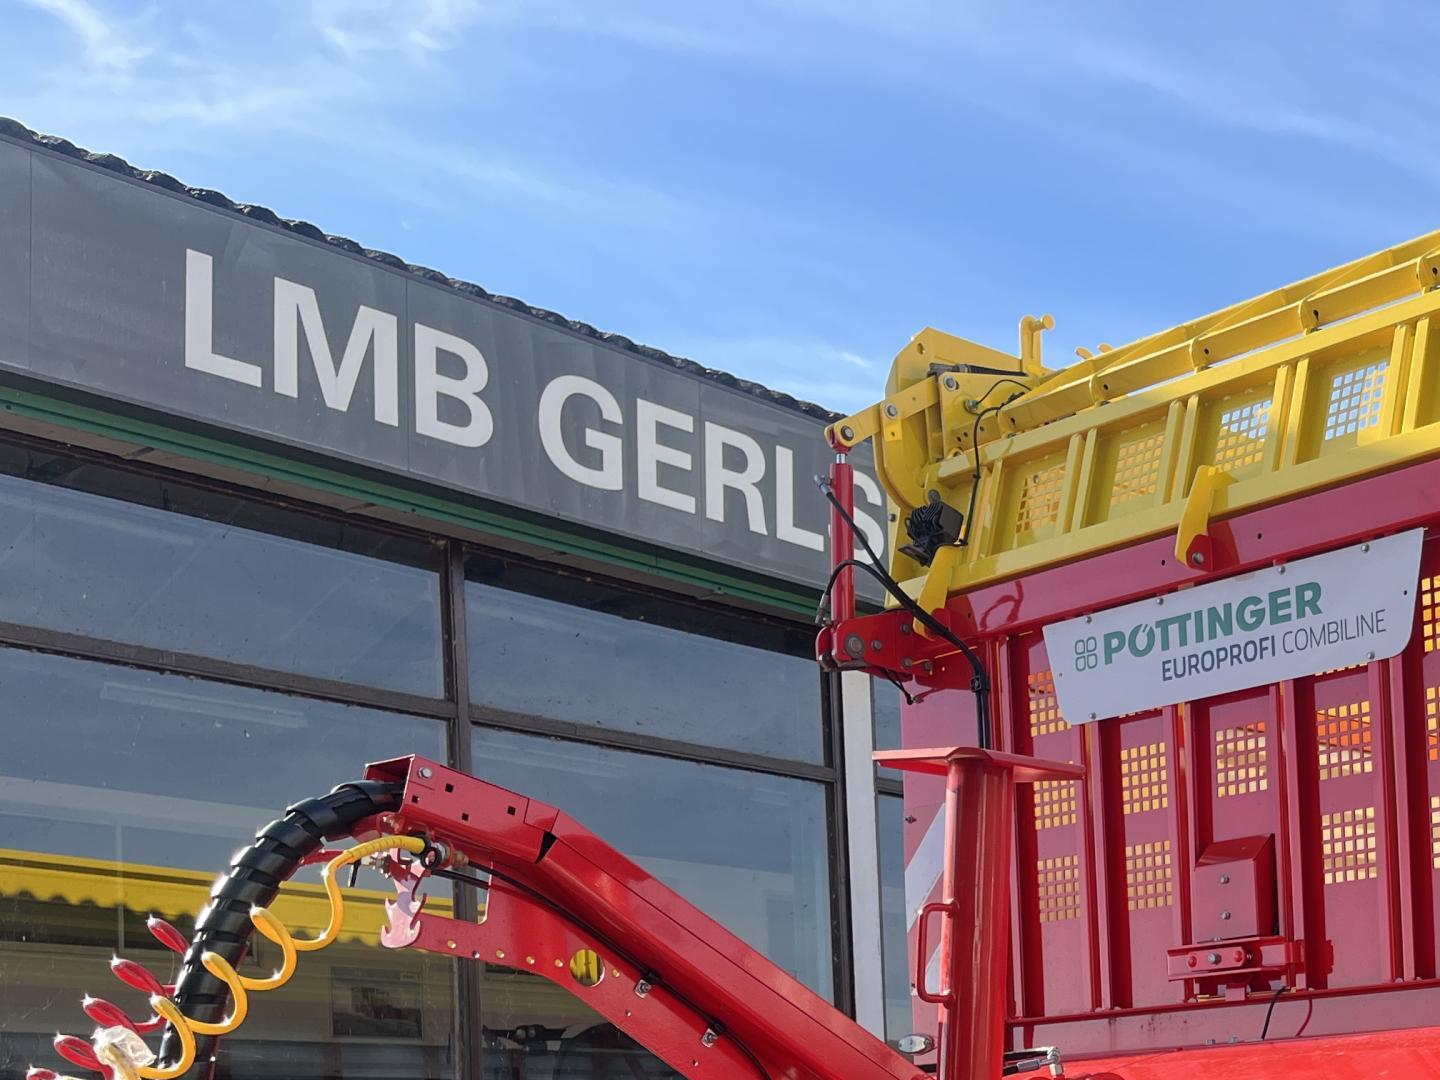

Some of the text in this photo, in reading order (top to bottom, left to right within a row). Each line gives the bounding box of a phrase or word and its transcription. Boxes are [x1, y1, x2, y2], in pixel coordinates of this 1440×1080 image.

[185, 248, 884, 566] LMB GERLS
[1103, 581, 1323, 665] PÖTTINGER
[1162, 608, 1387, 682] EUROPROFI COMBILINE
